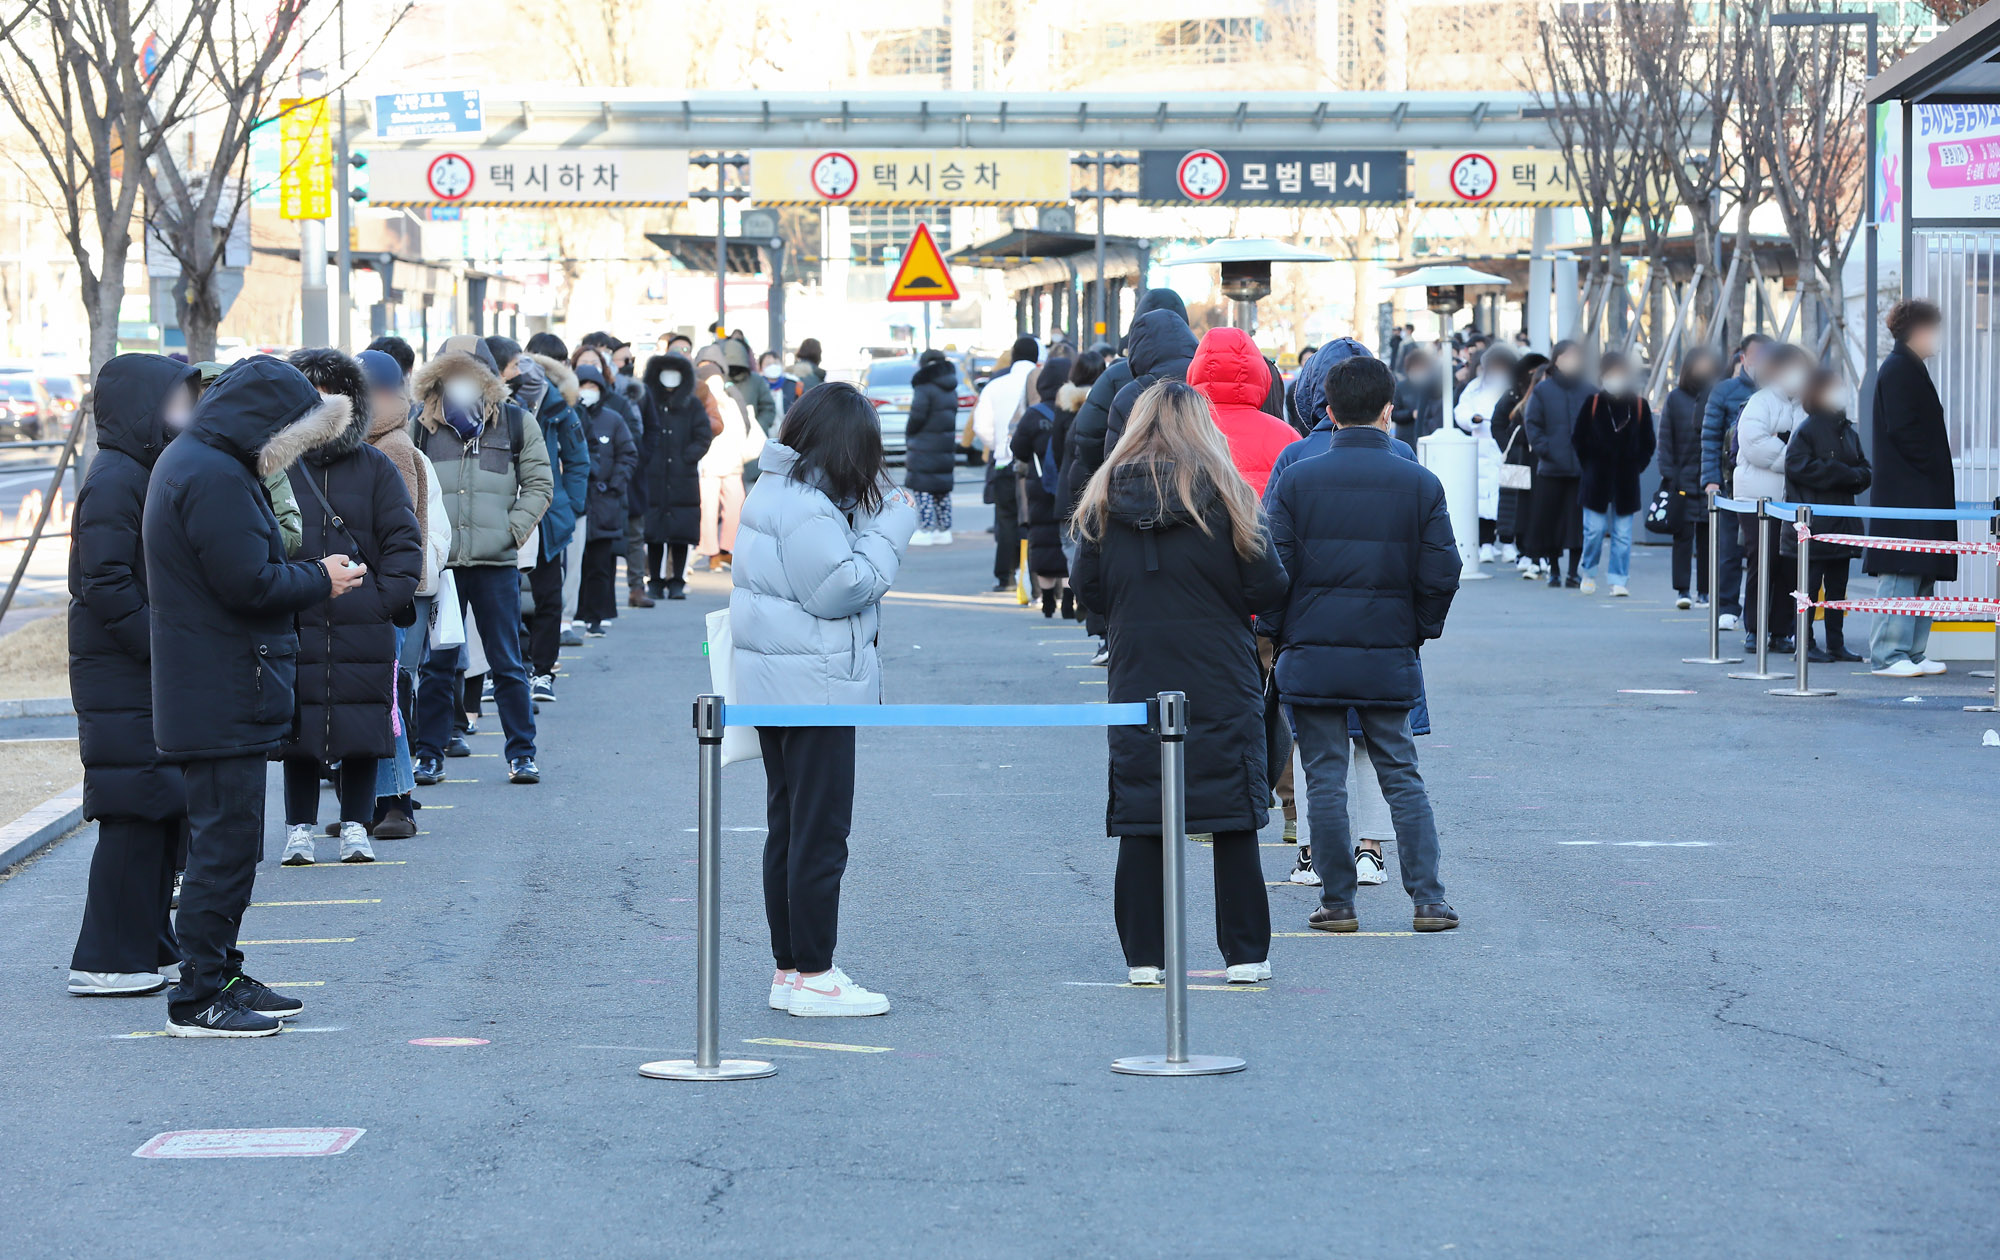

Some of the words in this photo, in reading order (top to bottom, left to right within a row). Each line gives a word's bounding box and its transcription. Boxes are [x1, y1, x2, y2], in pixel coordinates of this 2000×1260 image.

[490, 163, 618, 192] 택시하차
[873, 162, 1000, 191] 택시승차
[1240, 161, 1370, 193] 모범택시
